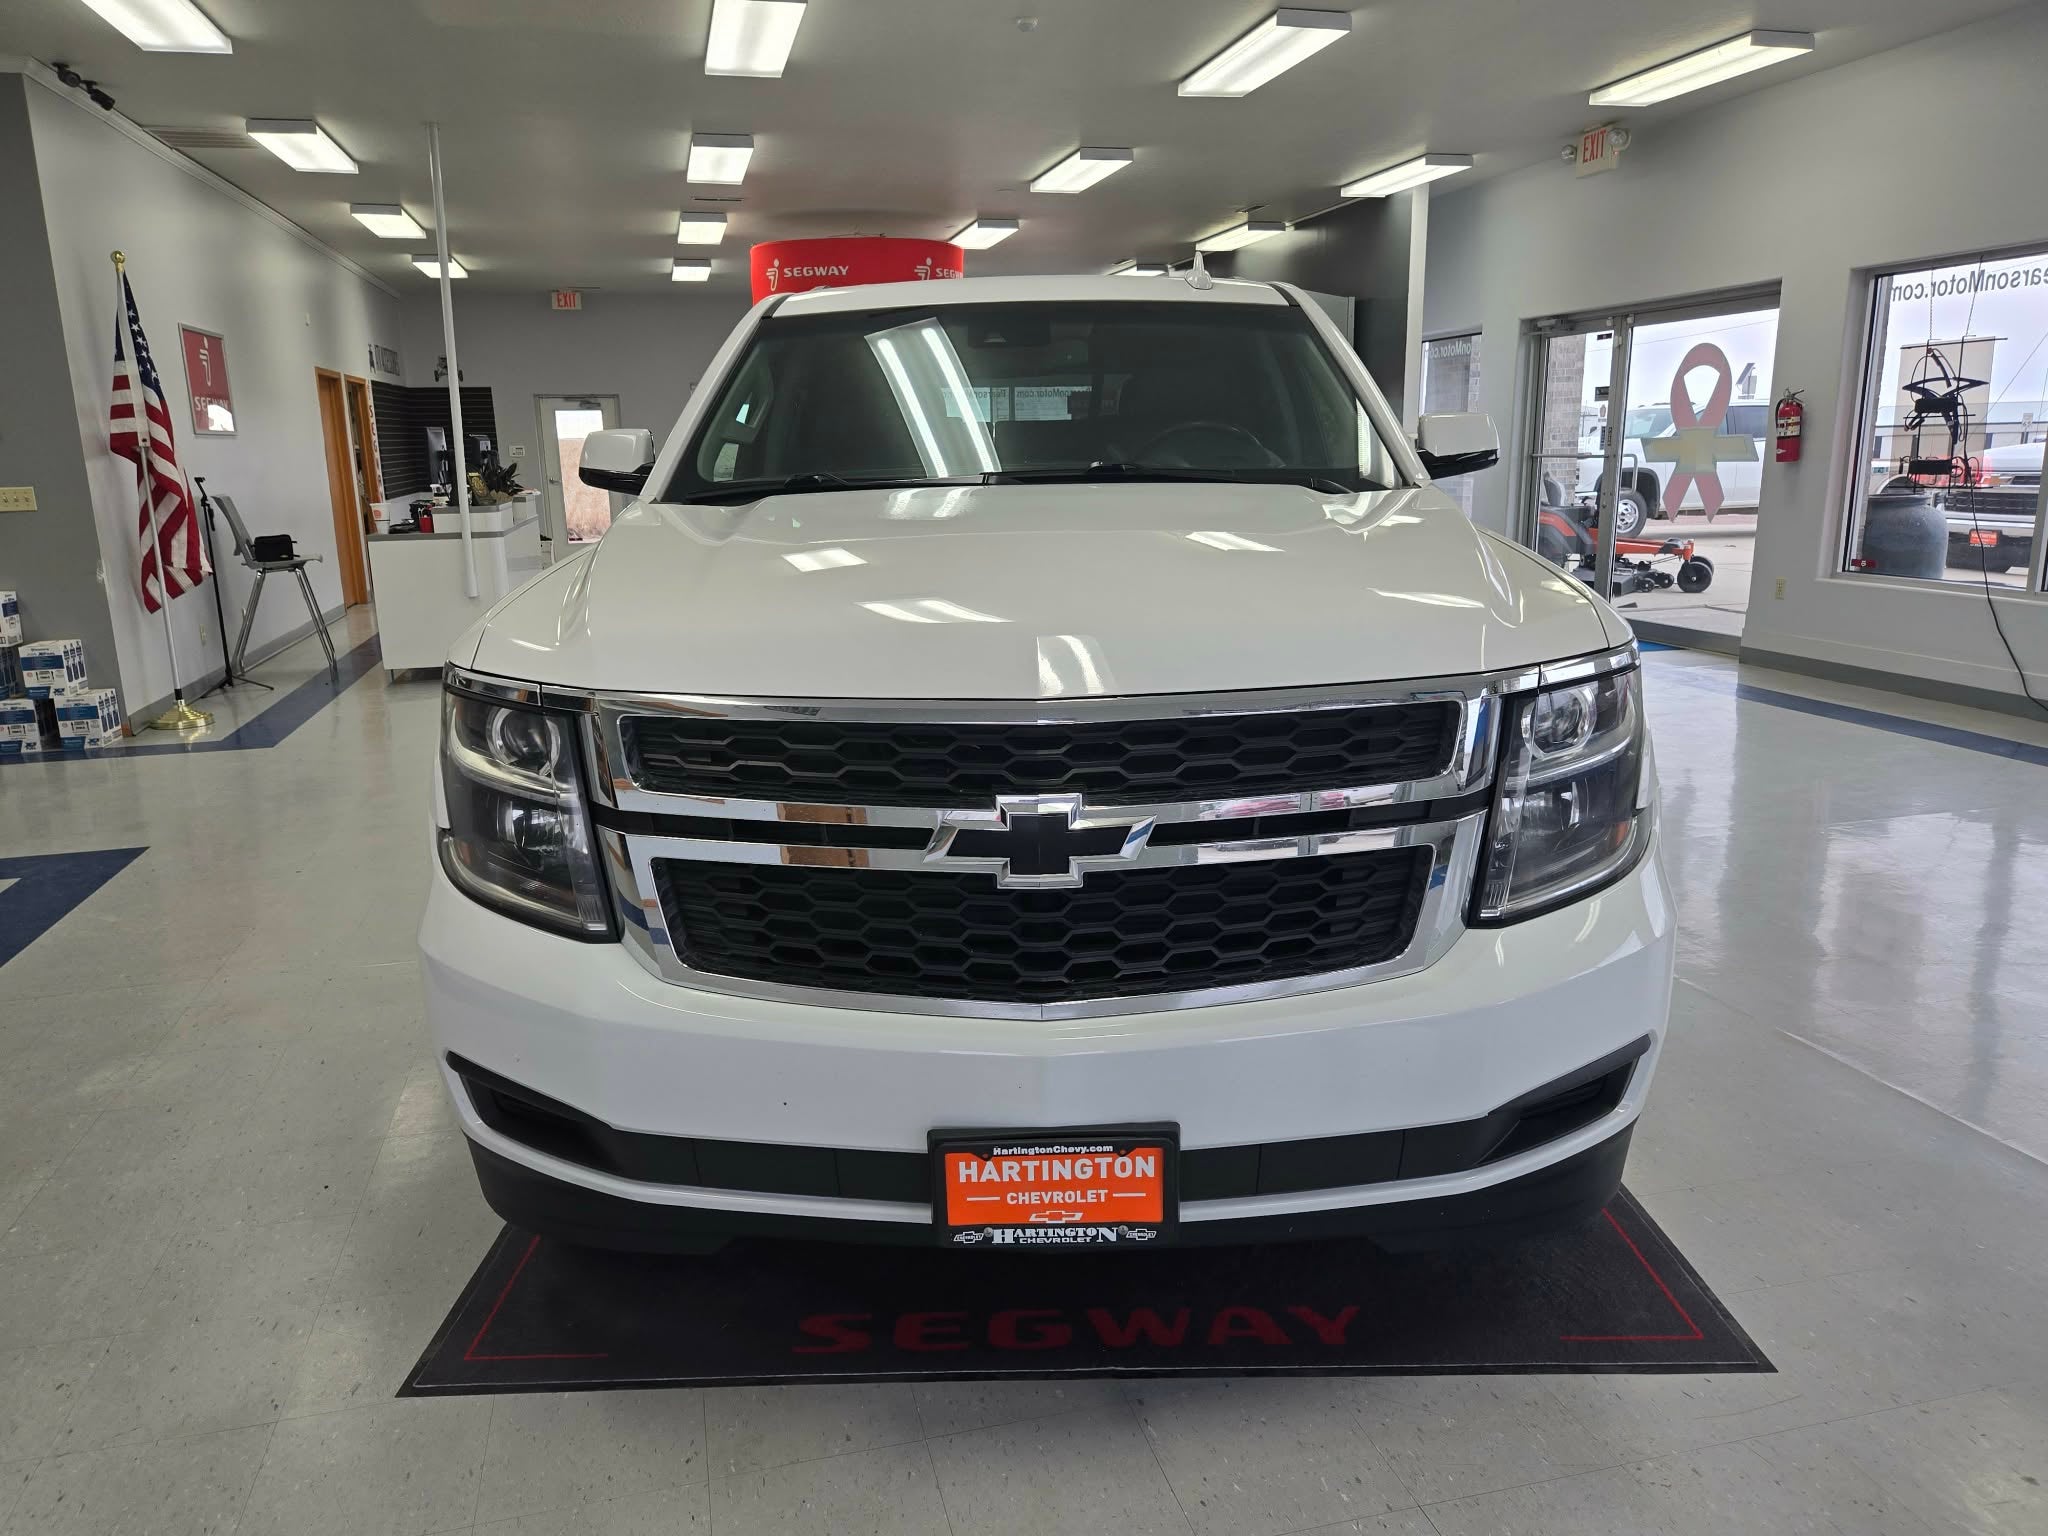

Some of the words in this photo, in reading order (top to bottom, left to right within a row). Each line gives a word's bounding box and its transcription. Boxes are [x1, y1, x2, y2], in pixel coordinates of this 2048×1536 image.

[1583, 128, 1606, 163] EXIT
[783, 266, 849, 278] SEGWAY
[556, 292, 577, 308] EXIT
[993, 1145, 1113, 1155] HartingtonChevy.com
[959, 1156, 1155, 1183] HARTINGTON
[1006, 1190, 1108, 1205] CHEVROLET
[992, 1227, 1118, 1244] HARTINGTON
[1020, 1236, 1092, 1244] CHEVROLET
[792, 1306, 1360, 1353] SEGWAY
